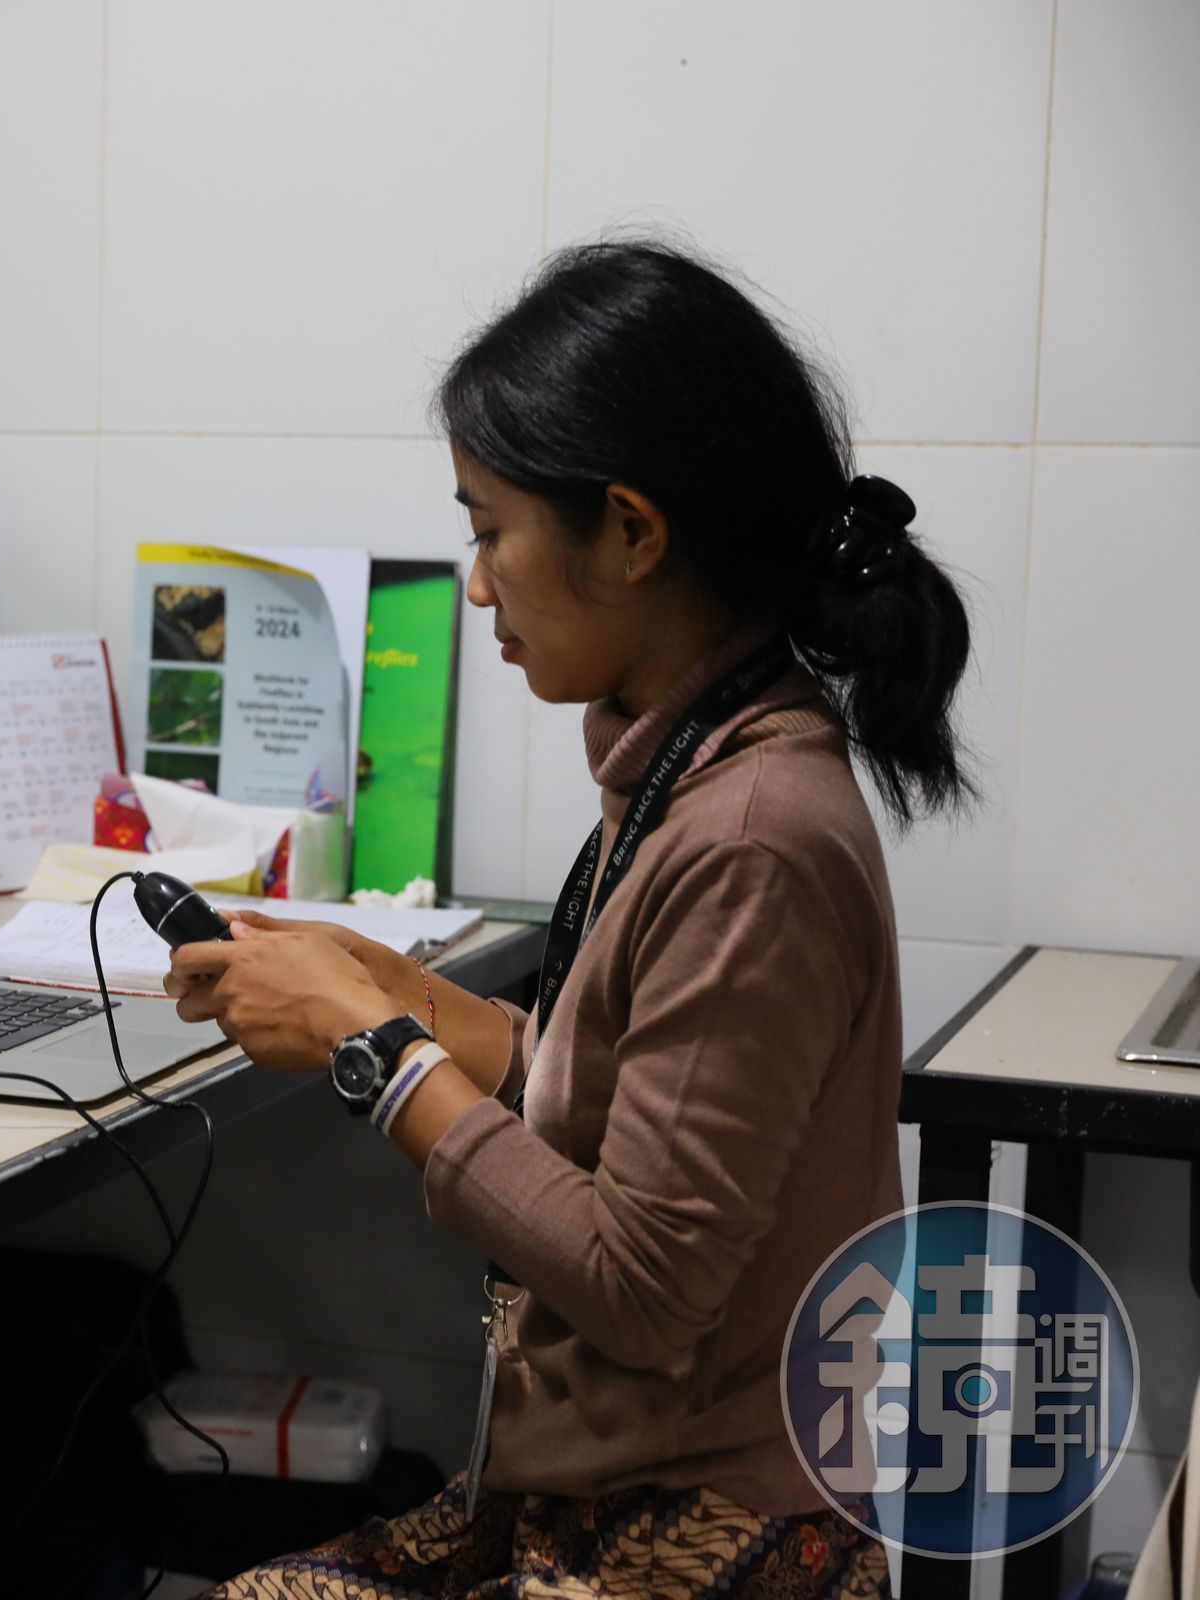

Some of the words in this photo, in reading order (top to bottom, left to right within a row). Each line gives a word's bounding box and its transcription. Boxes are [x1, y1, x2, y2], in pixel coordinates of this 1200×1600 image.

[256, 617, 301, 639] 2024
[366, 647, 419, 669] reflies
[612, 823, 638, 867] BRING
[633, 785, 656, 823] BACK
[651, 757, 673, 787] THE
[669, 719, 701, 761] LIGHT
[577, 862, 594, 889] THE
[562, 890, 585, 931] LIGHT
